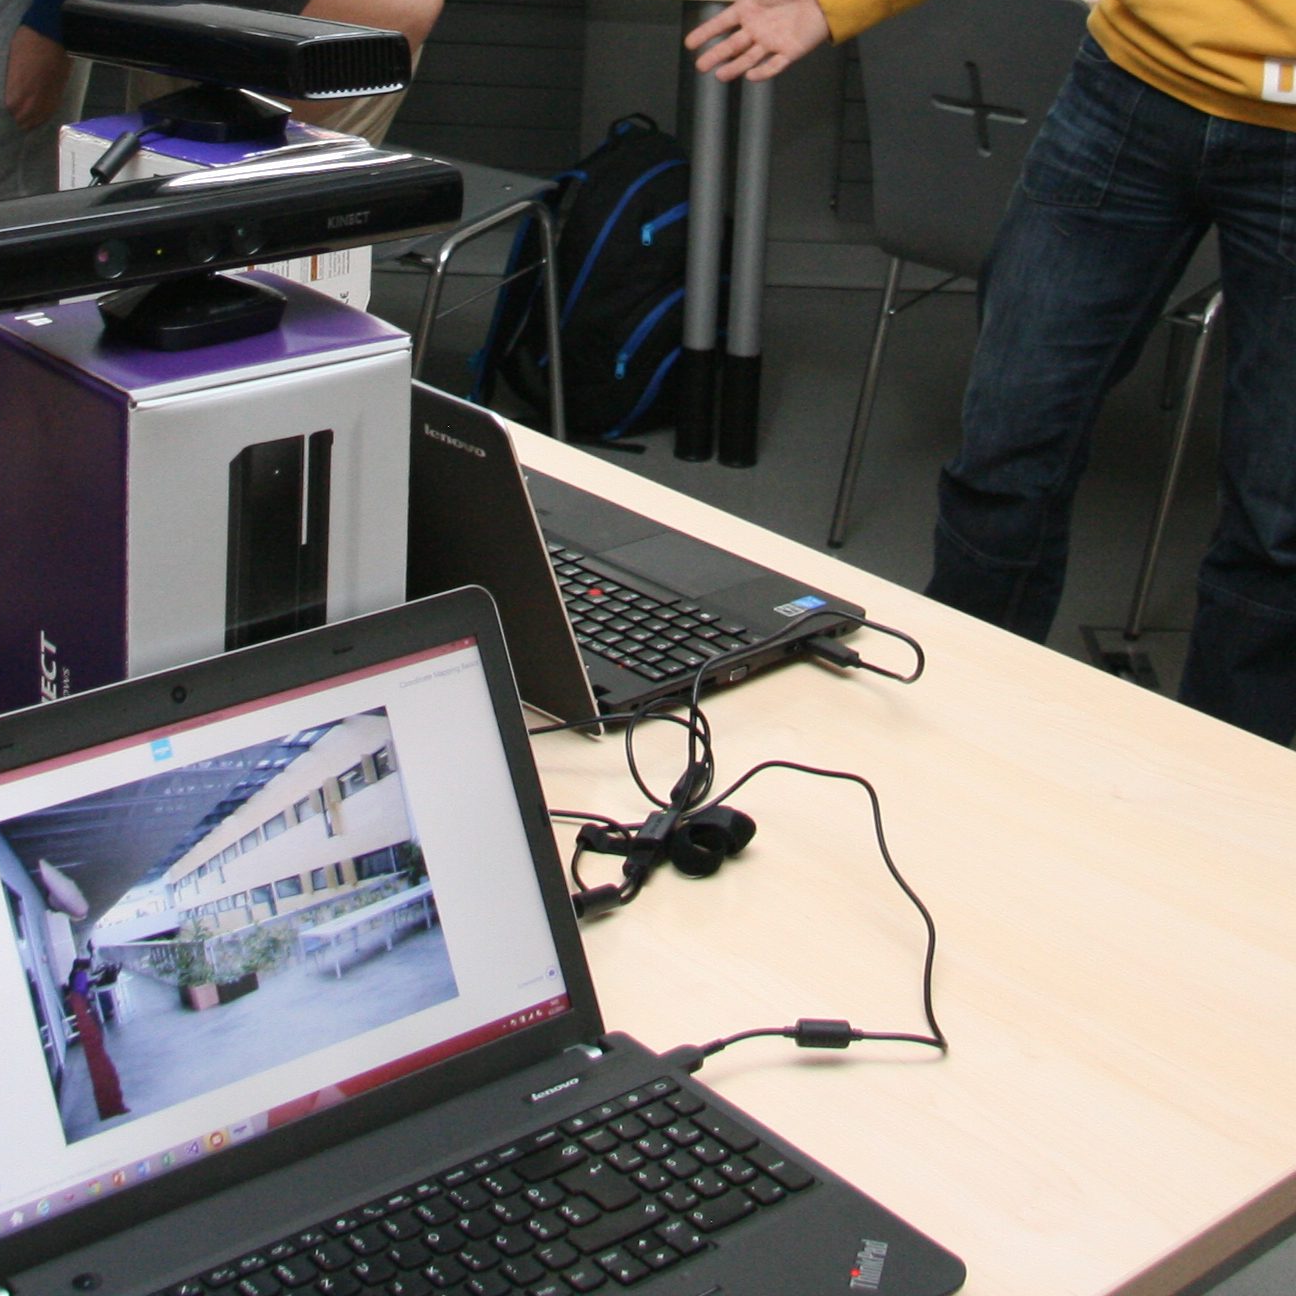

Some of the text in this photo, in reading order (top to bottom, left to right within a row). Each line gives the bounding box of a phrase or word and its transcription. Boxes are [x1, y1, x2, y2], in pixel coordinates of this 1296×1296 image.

[327, 210, 371, 229] KINECT
[424, 423, 487, 458] lenovo
[40, 629, 57, 703] ECT
[531, 1077, 580, 1102] lenovo
